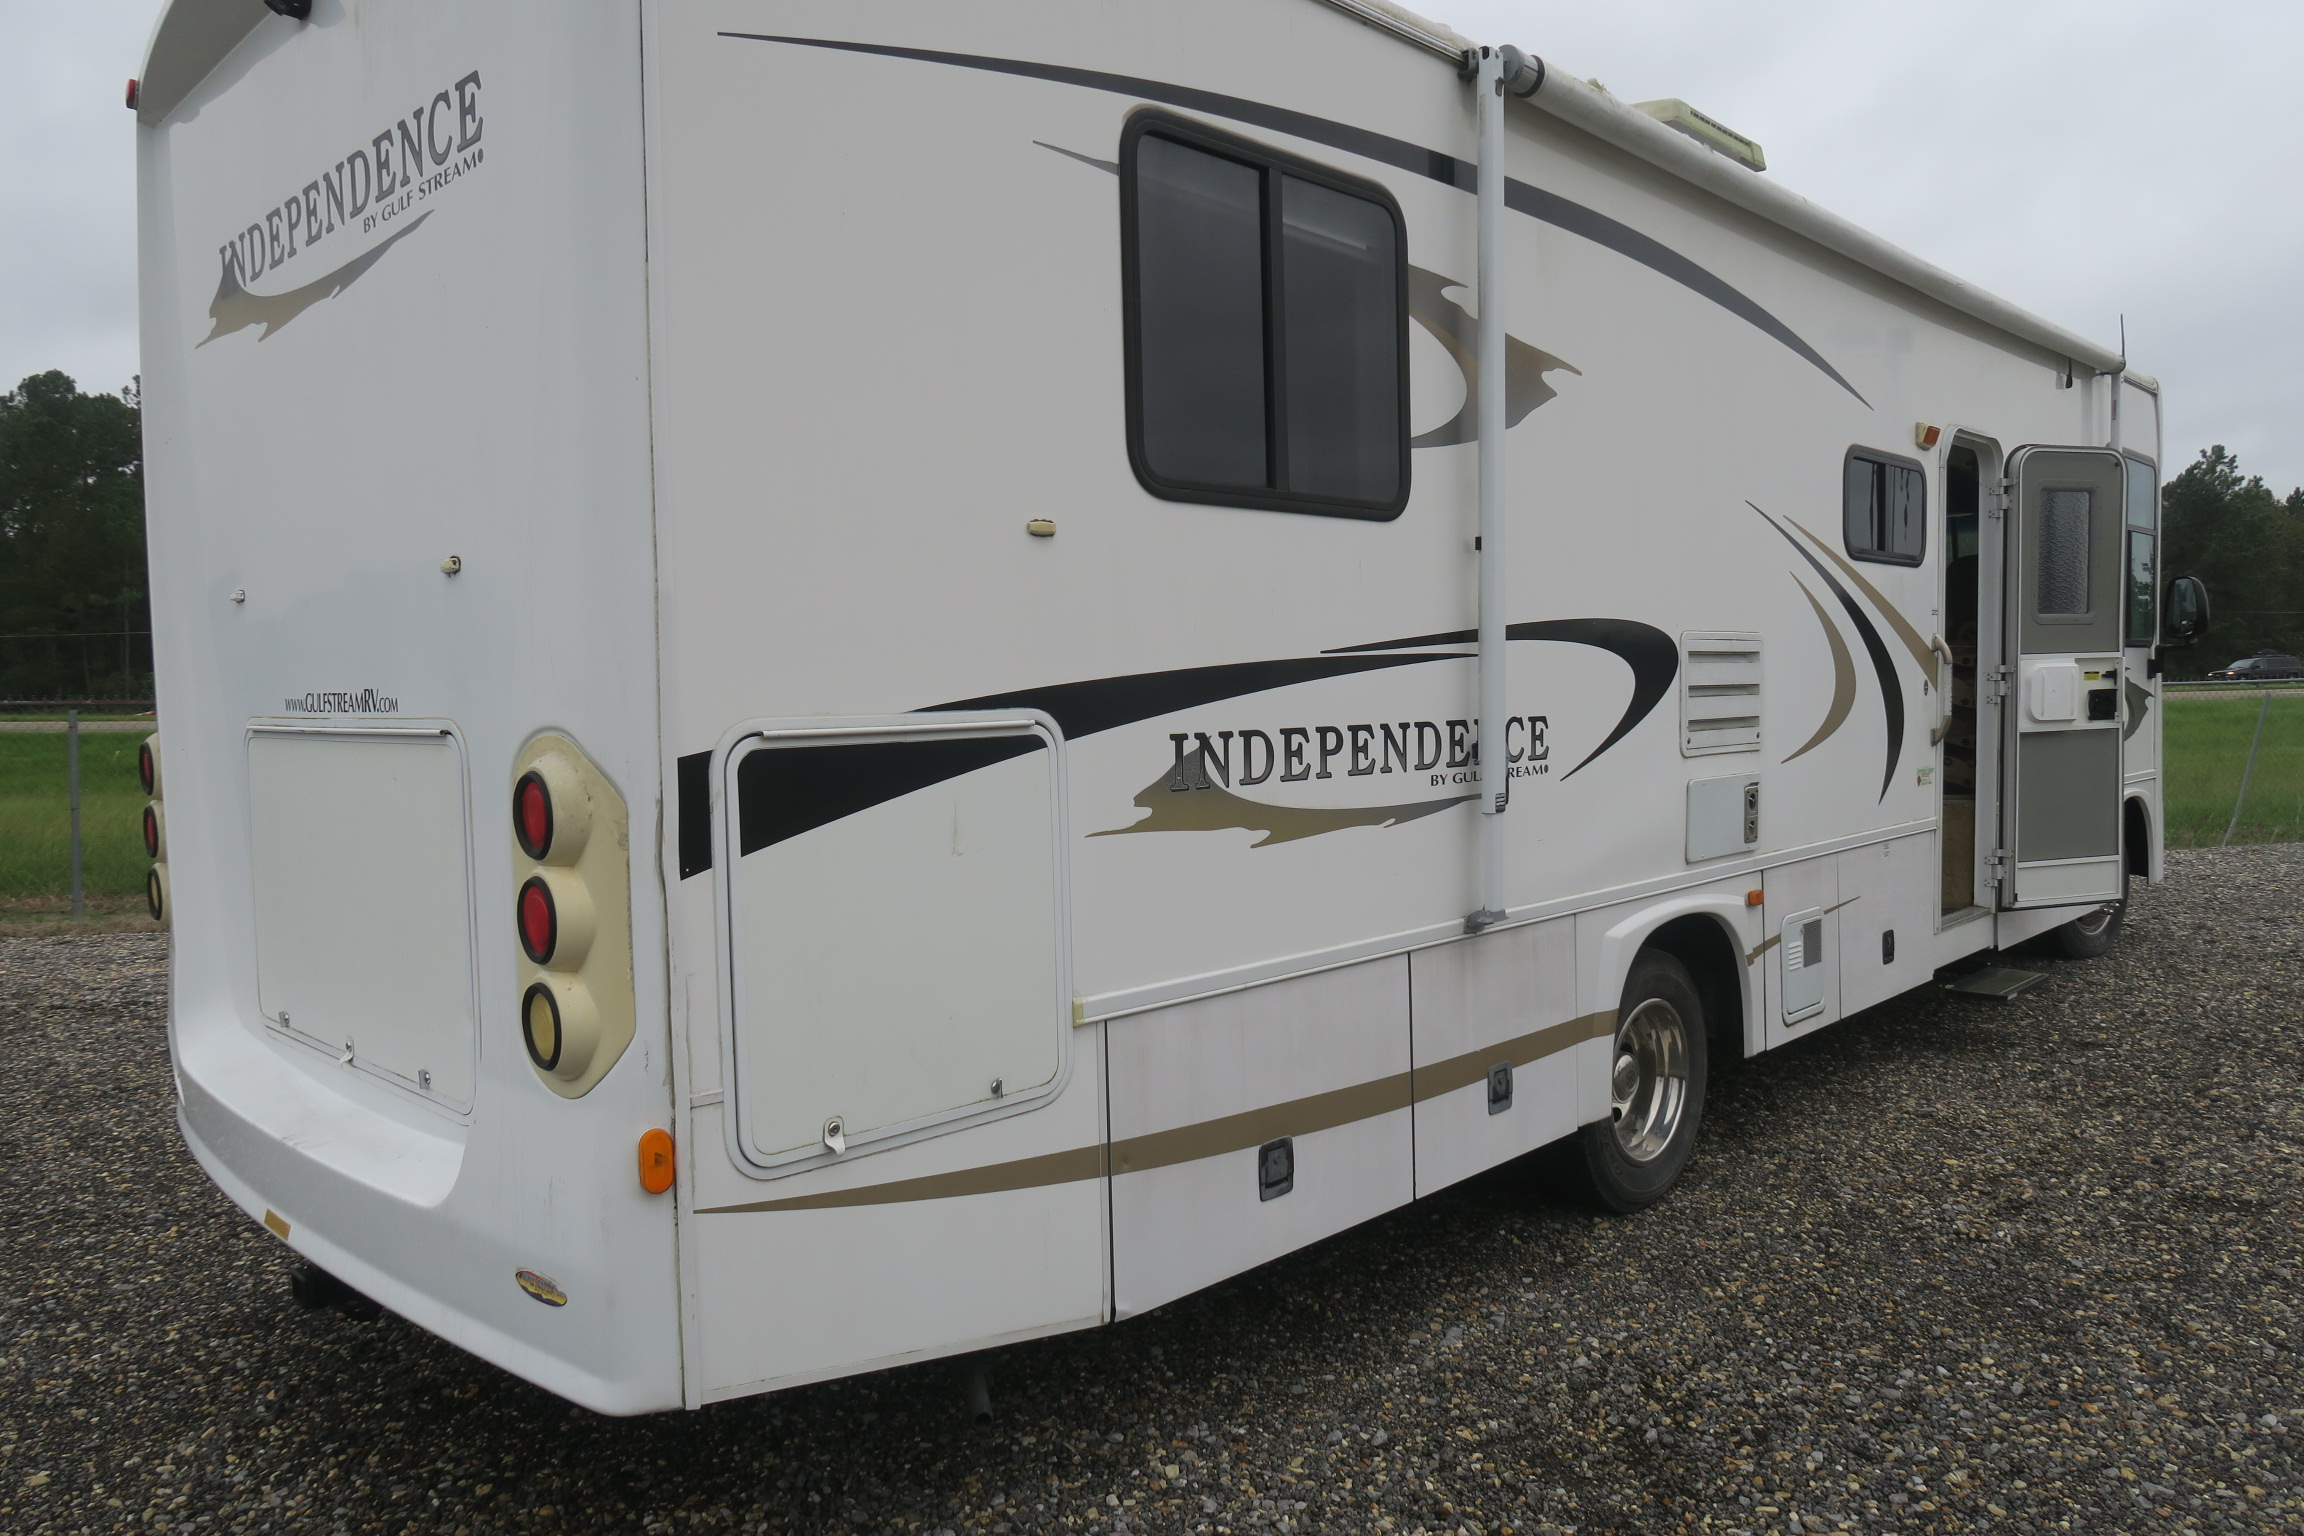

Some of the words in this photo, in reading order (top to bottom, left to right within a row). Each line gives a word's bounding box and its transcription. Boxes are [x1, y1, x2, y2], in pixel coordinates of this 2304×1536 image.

[219, 70, 483, 288] INDEPENDENCE
[363, 211, 378, 234] BY
[381, 189, 414, 222] GULF
[1169, 715, 1550, 792] INDEPENDECE
[1430, 774, 1449, 787] BY
[1452, 770, 1482, 784] GUL
